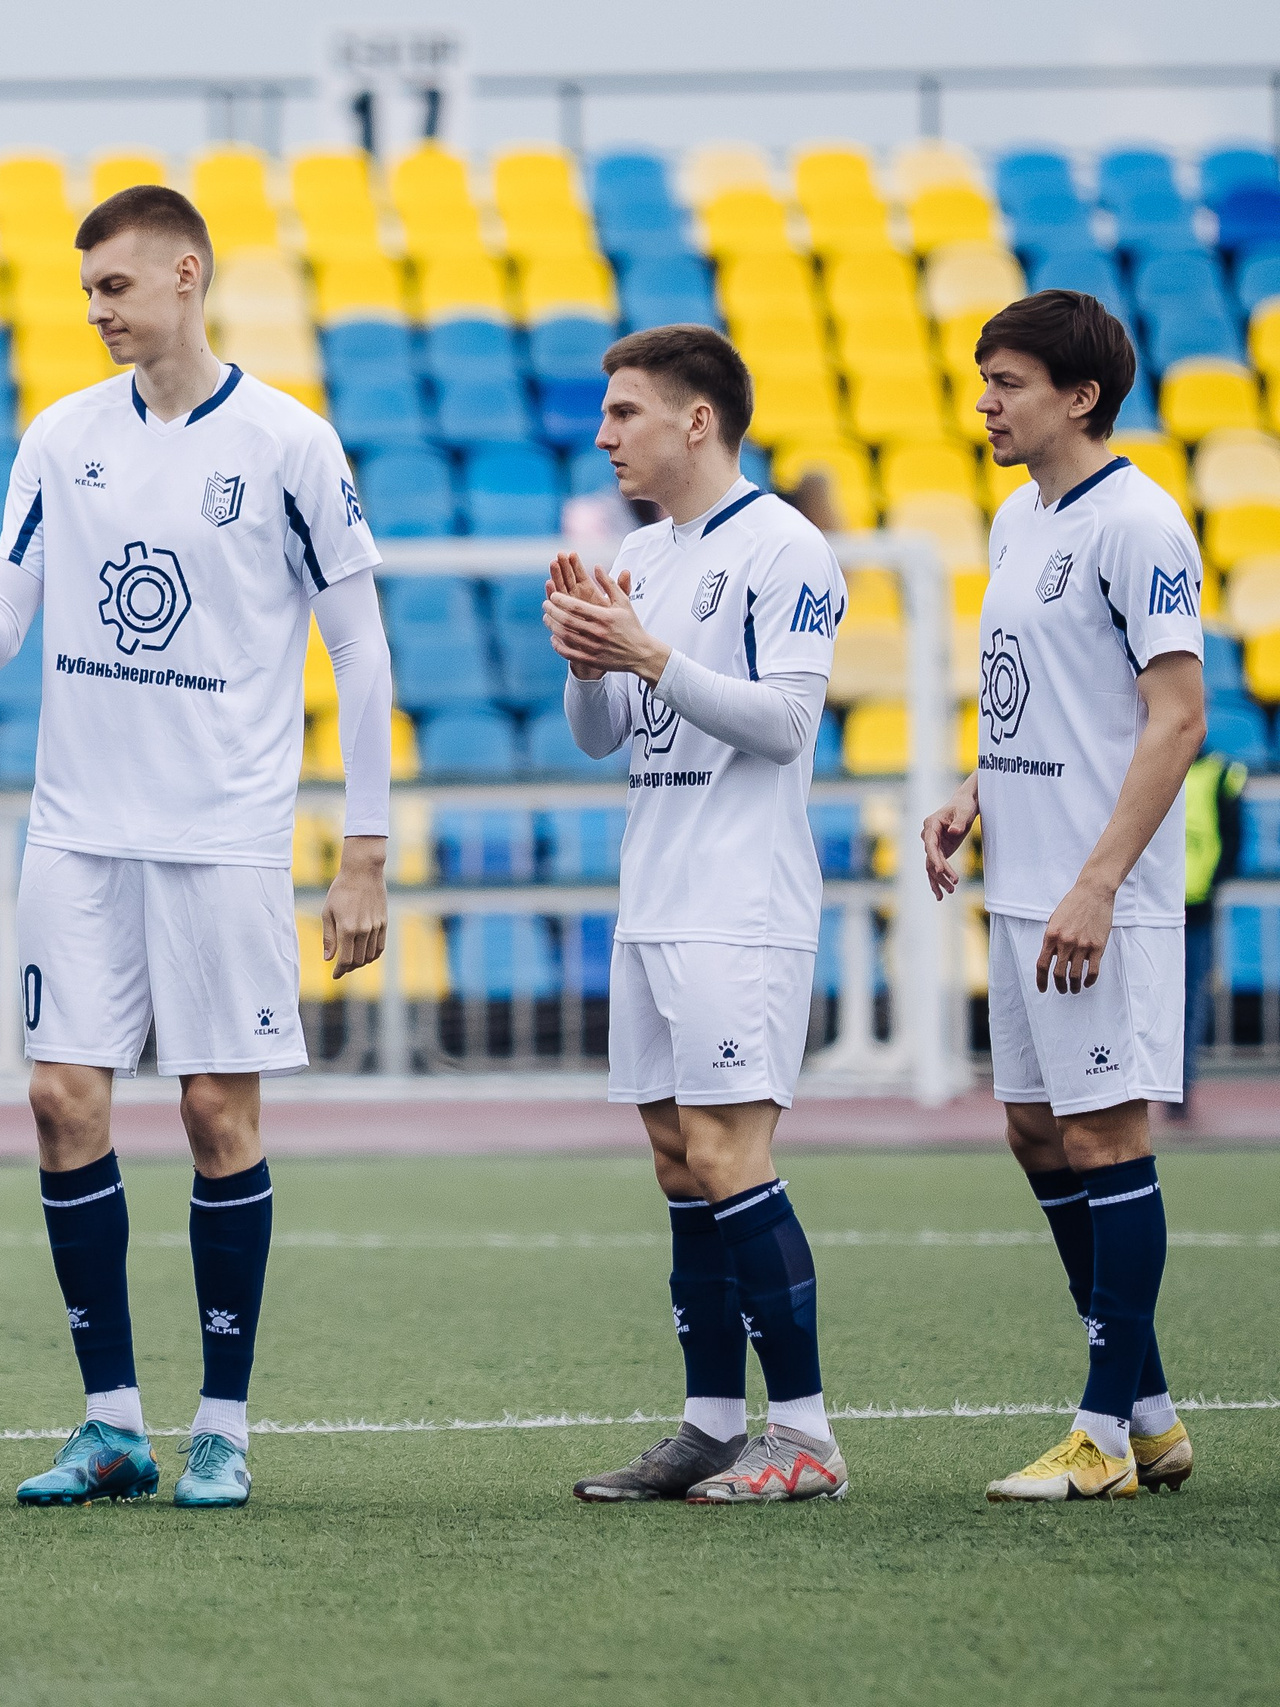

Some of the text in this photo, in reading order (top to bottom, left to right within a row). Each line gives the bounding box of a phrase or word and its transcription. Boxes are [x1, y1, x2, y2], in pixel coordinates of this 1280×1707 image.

[75, 478, 106, 489] KELME
[56, 653, 227, 693] КубаньЭнергоРемонт
[20, 964, 42, 1031] 0
[712, 1060, 746, 1069] KELME
[1085, 1063, 1120, 1076] KELME
[205, 1323, 240, 1335] KELME
